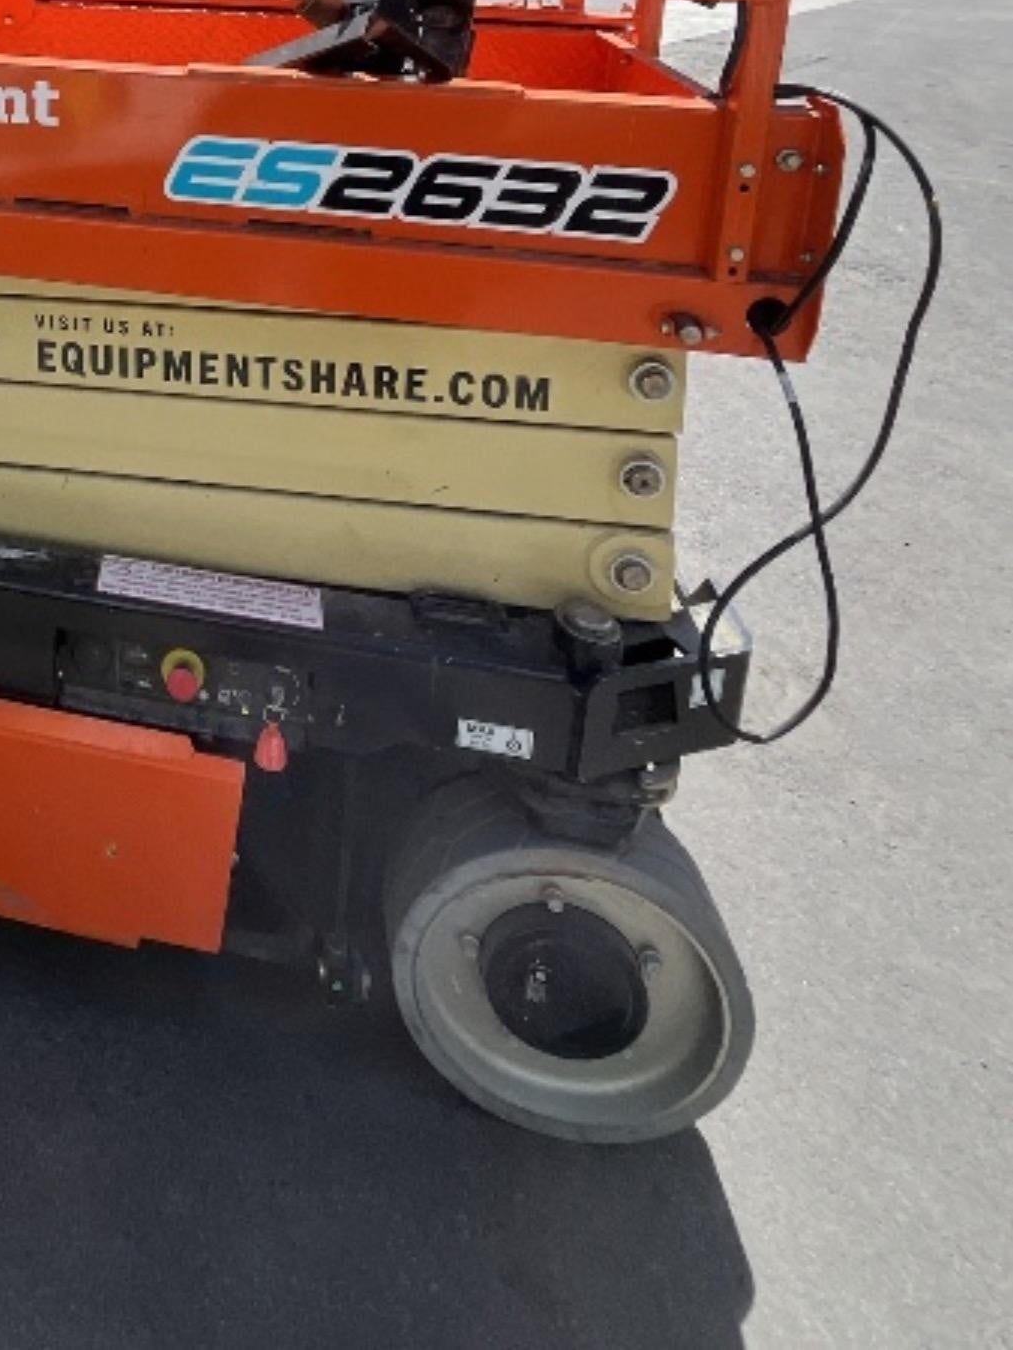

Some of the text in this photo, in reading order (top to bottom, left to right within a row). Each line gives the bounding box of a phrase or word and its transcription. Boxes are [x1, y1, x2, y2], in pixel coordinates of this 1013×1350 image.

[165, 134, 677, 244] ES2632
[34, 313, 175, 337] VISIT US AT:
[37, 338, 551, 412] EQUIPMENTSHARE.COM
